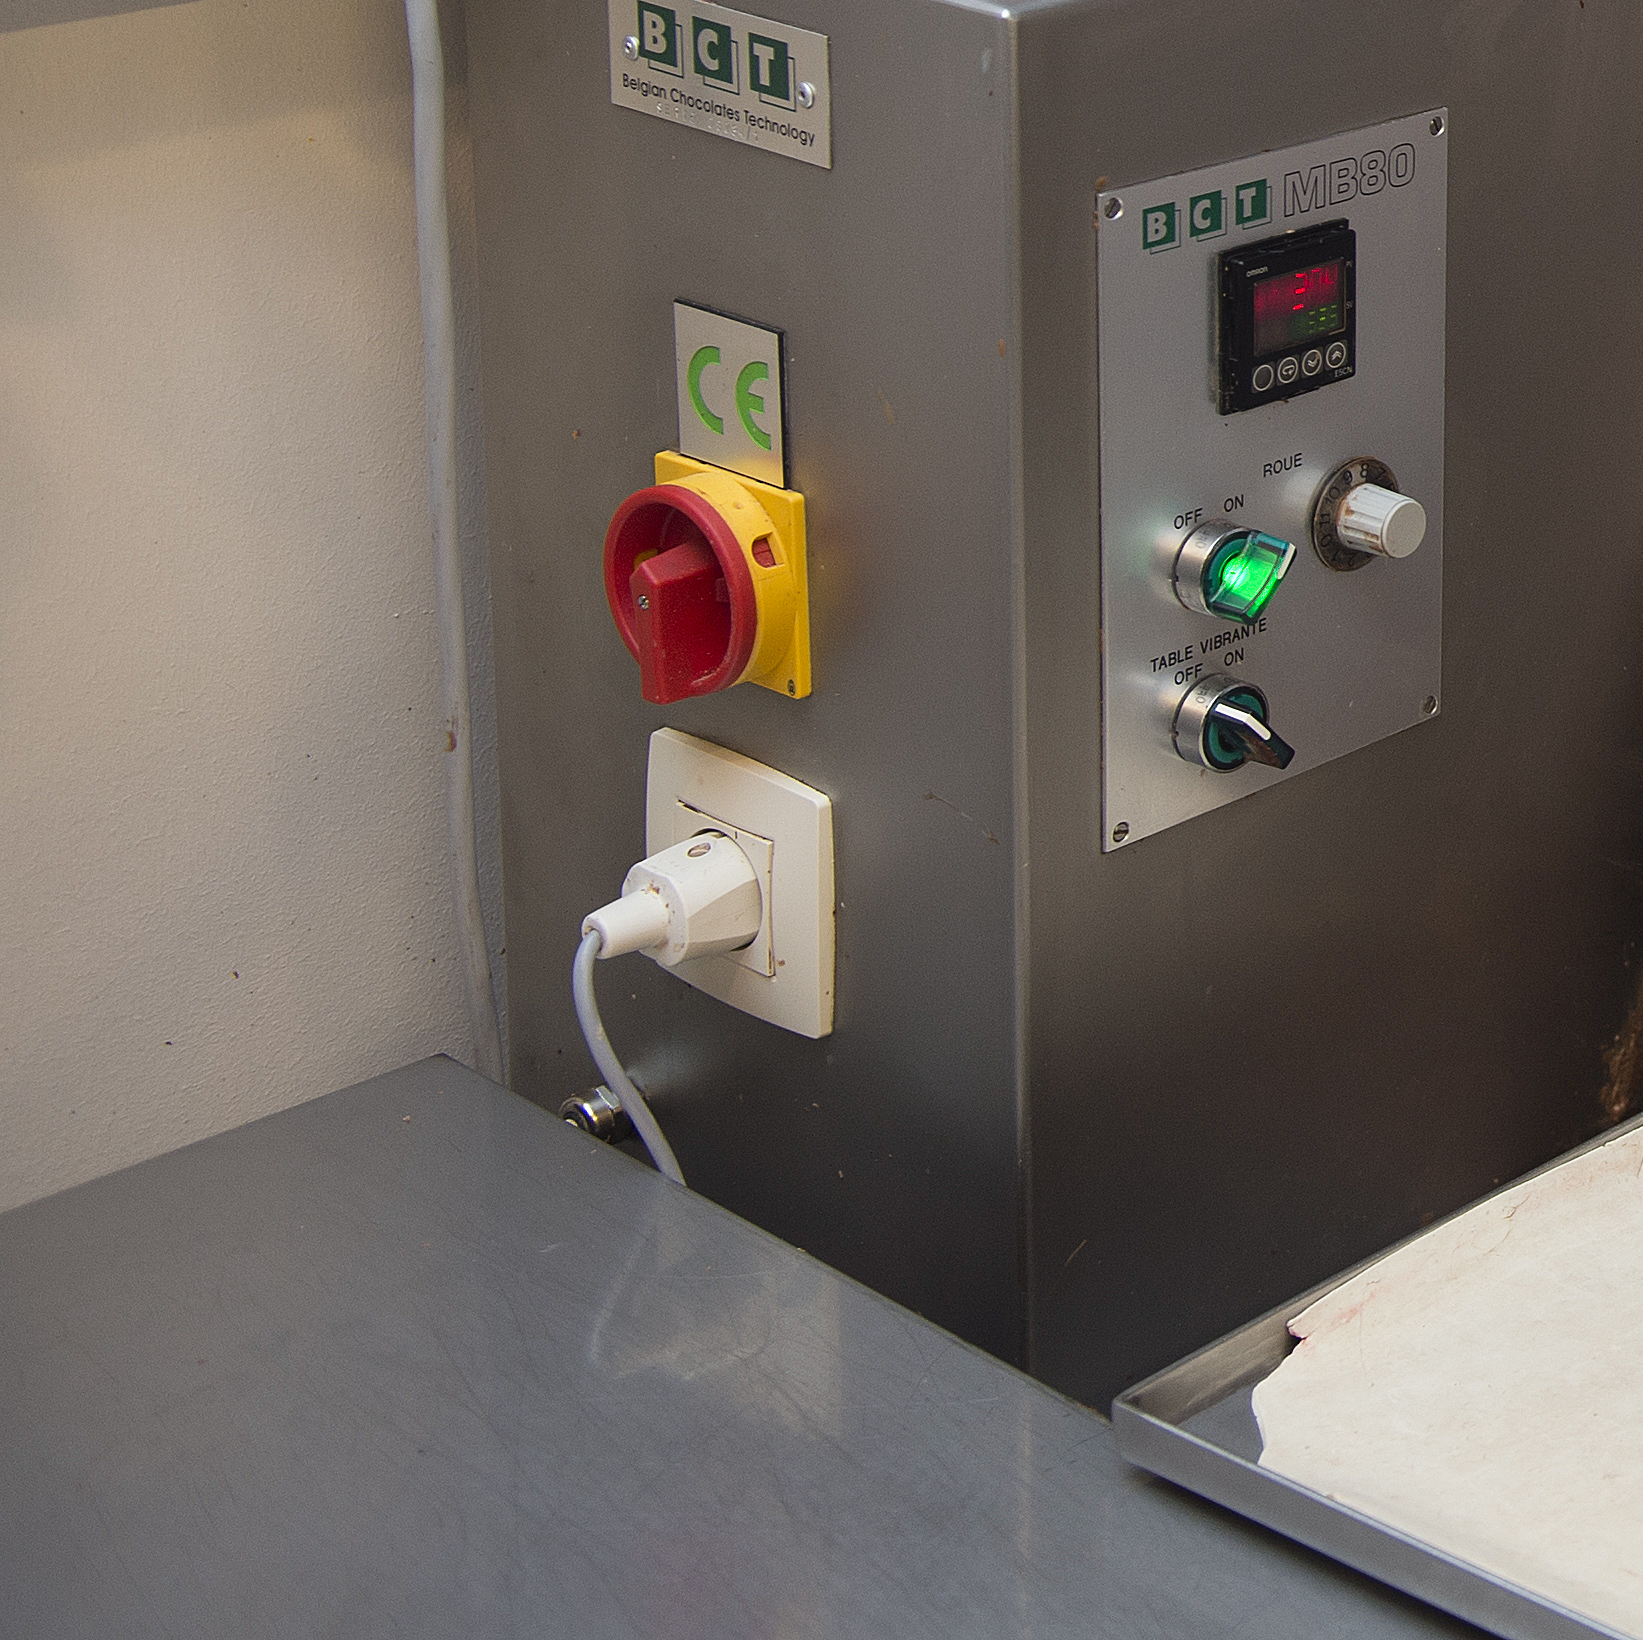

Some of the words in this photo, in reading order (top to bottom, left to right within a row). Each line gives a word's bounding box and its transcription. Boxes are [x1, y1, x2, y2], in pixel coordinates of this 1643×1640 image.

[640, 5, 783, 96] BCT
[622, 73, 667, 101] Belgian
[670, 88, 741, 123] Chocolates
[743, 109, 815, 147] Technology
[1283, 142, 1416, 218] MB80
[1144, 180, 1264, 246] BCT
[686, 344, 772, 452] CE
[1262, 452, 1303, 478] ROUE
[1361, 462, 1369, 478] 8
[1173, 507, 1203, 530] OFF
[1223, 493, 1245, 513] ON
[1150, 644, 1194, 673] TABLE
[1200, 617, 1268, 655] VIBRANTE
[1173, 662, 1204, 686] OFF
[1223, 647, 1245, 667] ON
